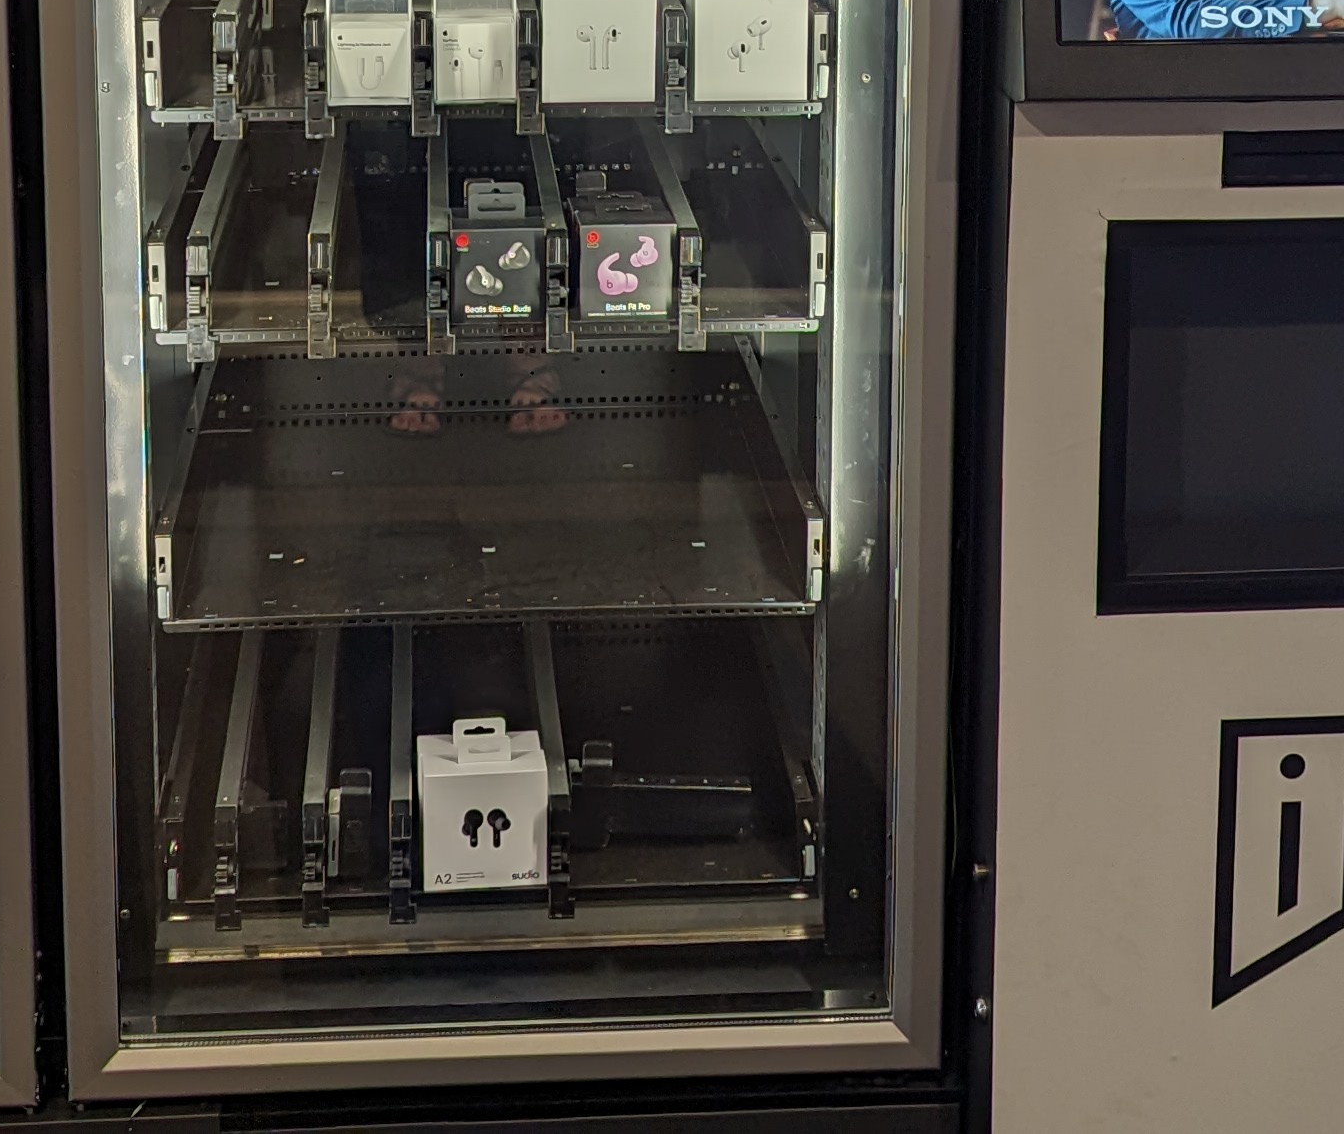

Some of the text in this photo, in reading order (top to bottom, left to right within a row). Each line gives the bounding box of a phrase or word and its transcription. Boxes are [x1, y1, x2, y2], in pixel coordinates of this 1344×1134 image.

[1200, 6, 1329, 28] SONY
[465, 304, 531, 313] Beats Studio Buds
[606, 303, 651, 311] Beats Pro
[434, 873, 452, 885] A2
[512, 869, 540, 880] sudio
